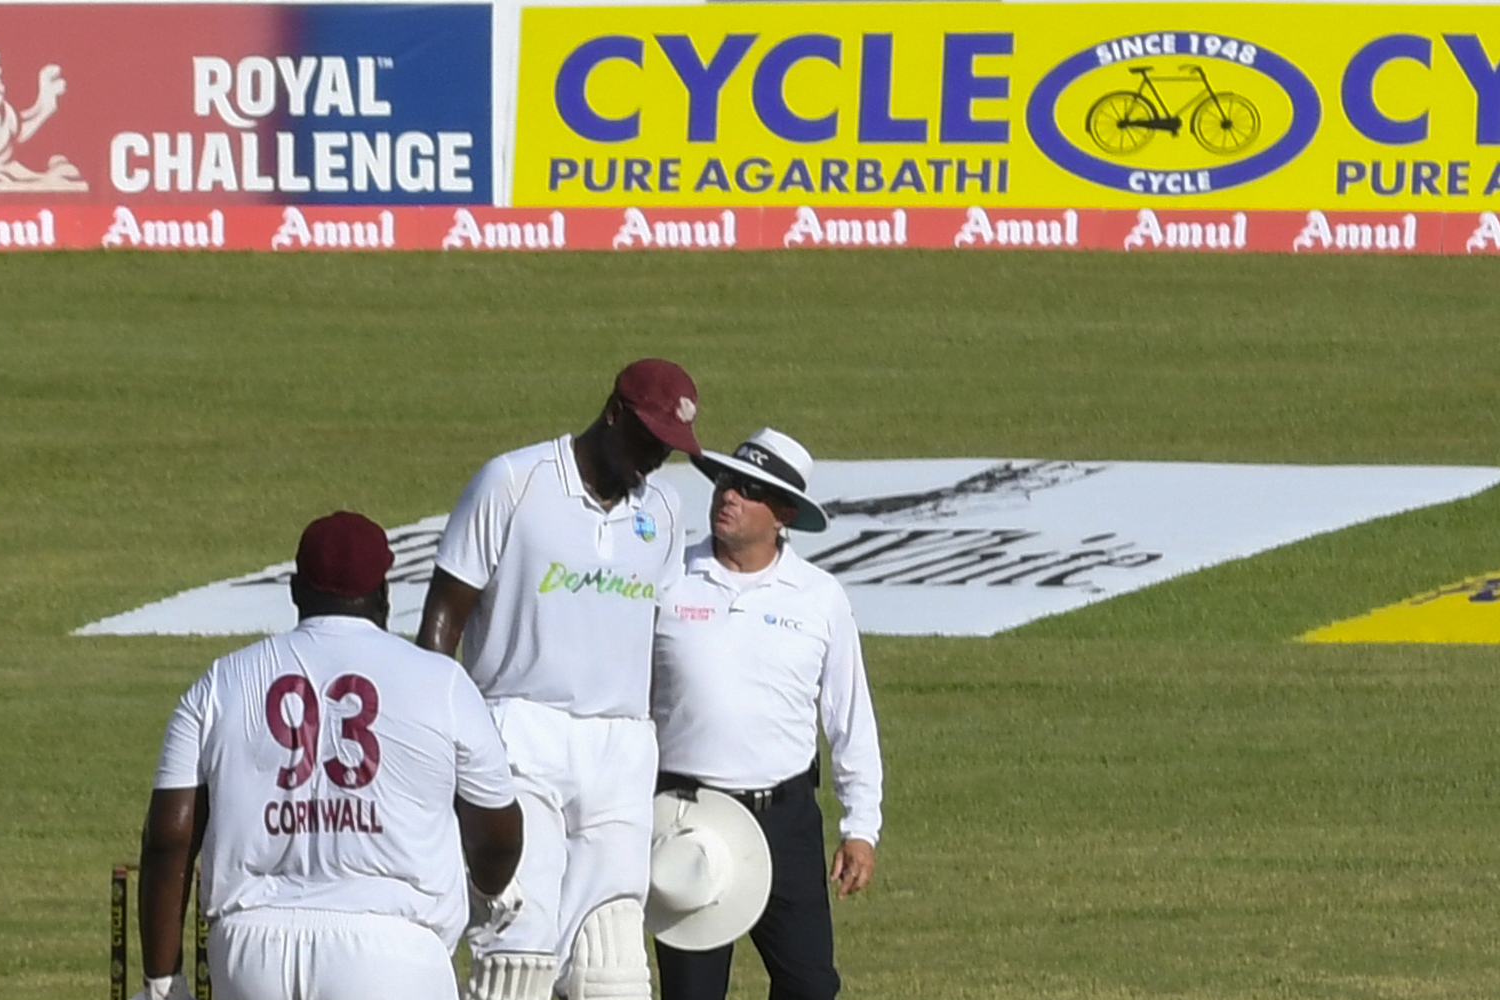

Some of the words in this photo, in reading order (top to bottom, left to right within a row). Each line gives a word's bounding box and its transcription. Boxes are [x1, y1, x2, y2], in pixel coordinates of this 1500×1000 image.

[1095, 33, 1177, 66] SINCE
[1189, 33, 1257, 65] 1948
[192, 55, 391, 129] ROYAL
[554, 32, 1014, 144] CYCLE
[109, 131, 474, 194] CHALLENGE
[549, 158, 681, 192] PURE
[694, 158, 1008, 193] AGARBATHI
[1128, 170, 1212, 194] CYCLE
[1336, 161, 1470, 196] PURE
[101, 206, 225, 249] Amul
[271, 206, 396, 250] Amul
[441, 207, 567, 250] Amul
[612, 207, 737, 250] Amul
[782, 206, 908, 249] Amul
[953, 206, 1079, 249] Amul
[1123, 208, 1248, 251] Amul
[1293, 210, 1418, 252] Amul
[264, 673, 381, 790] 93
[263, 800, 383, 836] CORNWALL
